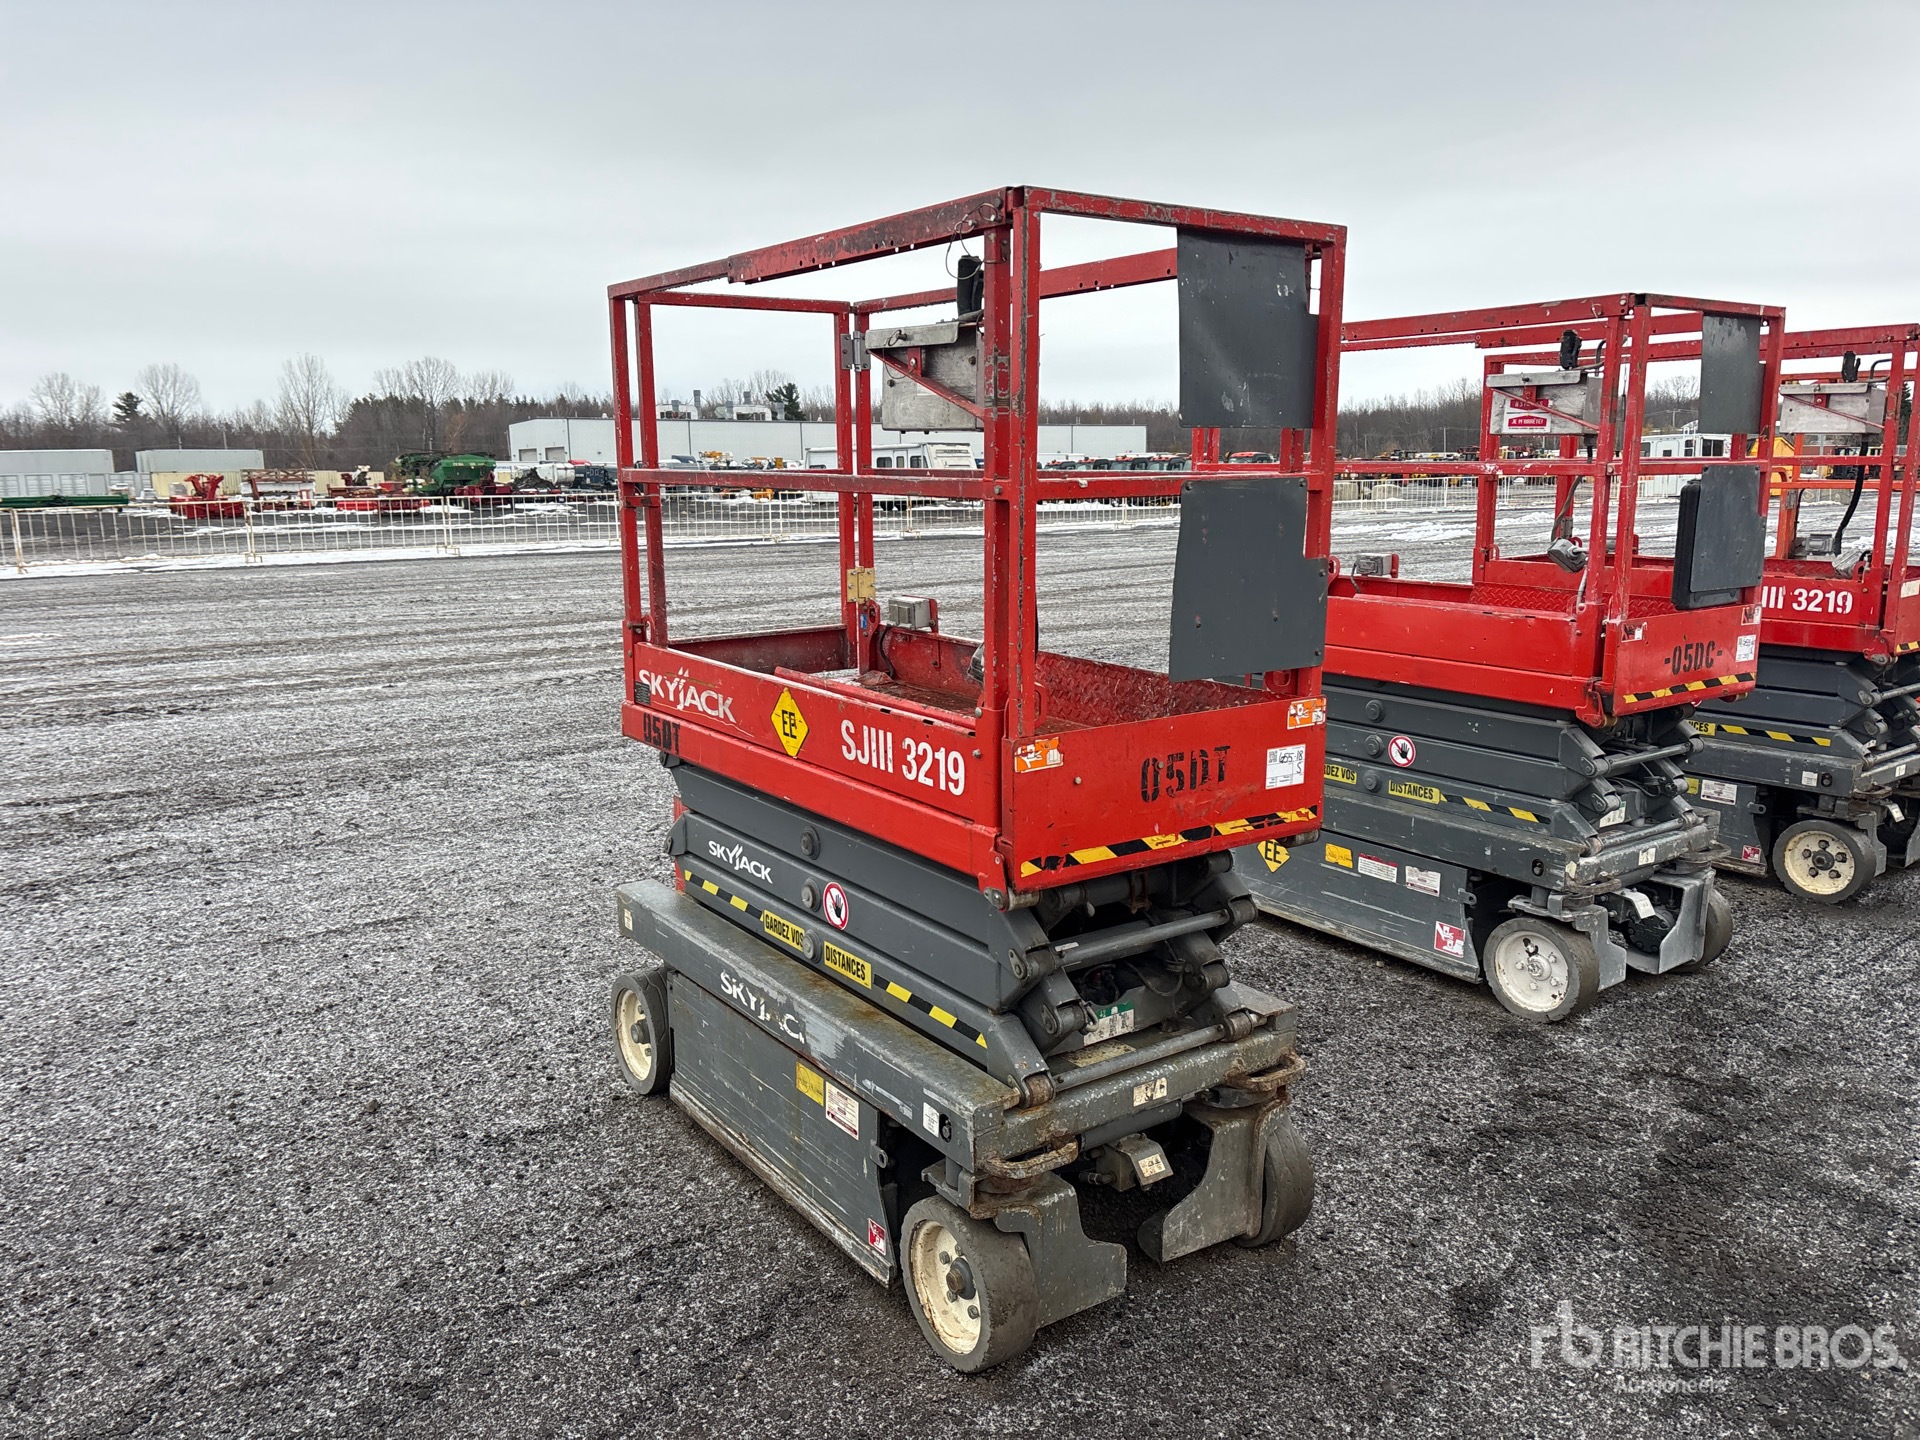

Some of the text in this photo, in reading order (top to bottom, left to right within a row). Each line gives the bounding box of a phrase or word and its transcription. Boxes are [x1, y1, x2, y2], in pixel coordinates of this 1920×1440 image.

[1792, 588, 1853, 614] 3219
[638, 666, 737, 724] SKYJACK
[901, 737, 965, 796] 3219
[1141, 745, 1231, 802] 05DT
[1341, 767, 1356, 781] VOS
[708, 840, 773, 885] SKYJACK
[1264, 840, 1282, 864] EE
[765, 913, 805, 948] GARDEZ VOS
[825, 945, 866, 981] DISTANCES
